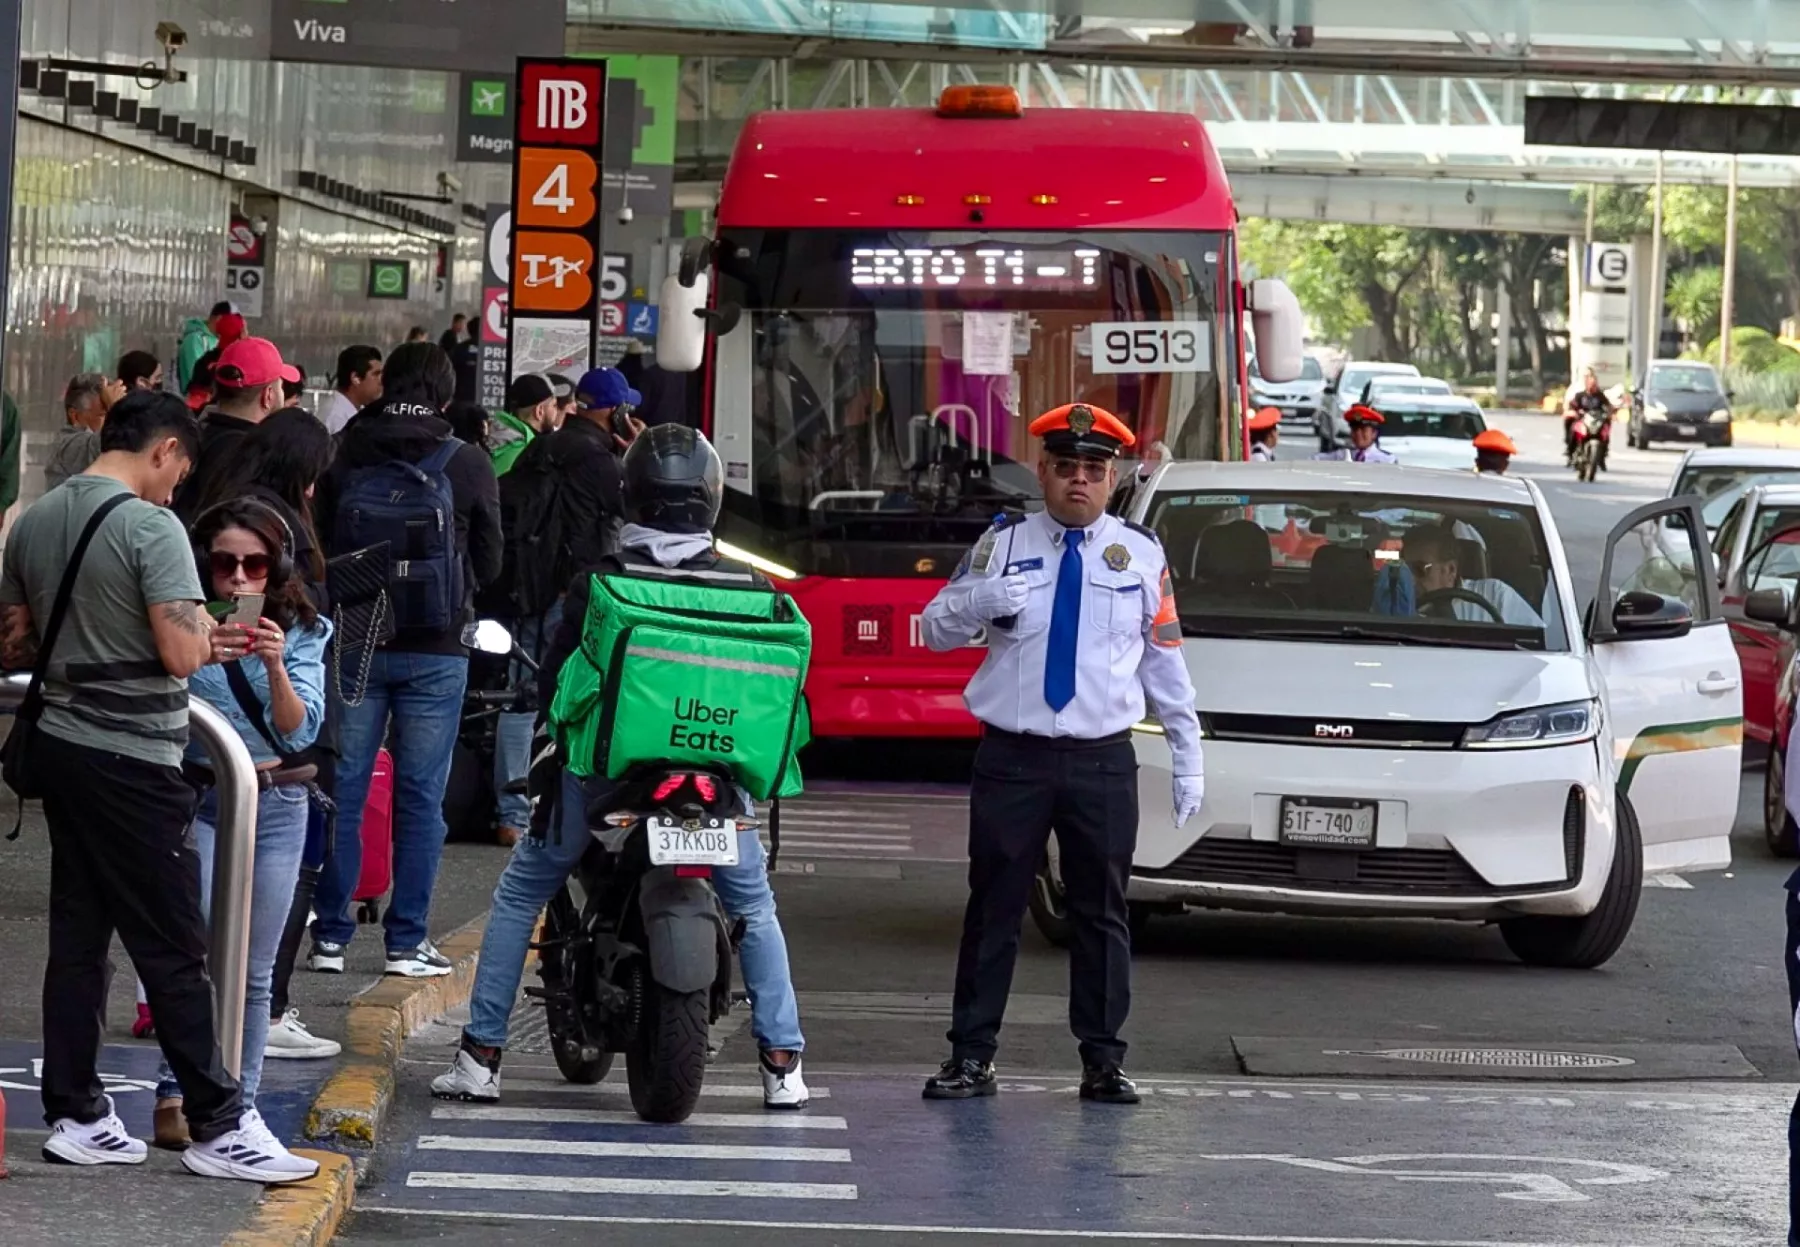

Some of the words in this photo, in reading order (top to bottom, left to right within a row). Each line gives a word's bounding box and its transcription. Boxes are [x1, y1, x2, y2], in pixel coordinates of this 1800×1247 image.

[293, 19, 346, 43] Viva
[537, 79, 588, 129] MB
[470, 134, 513, 152] Magn
[532, 164, 575, 214] 4
[600, 255, 626, 301] 5
[1105, 329, 1196, 364] 9513
[673, 696, 739, 726] Uber
[669, 724, 735, 753] Eats
[1315, 724, 1353, 737] BYD
[1284, 810, 1353, 833] 51F-740
[659, 831, 728, 852] 37KKD8
